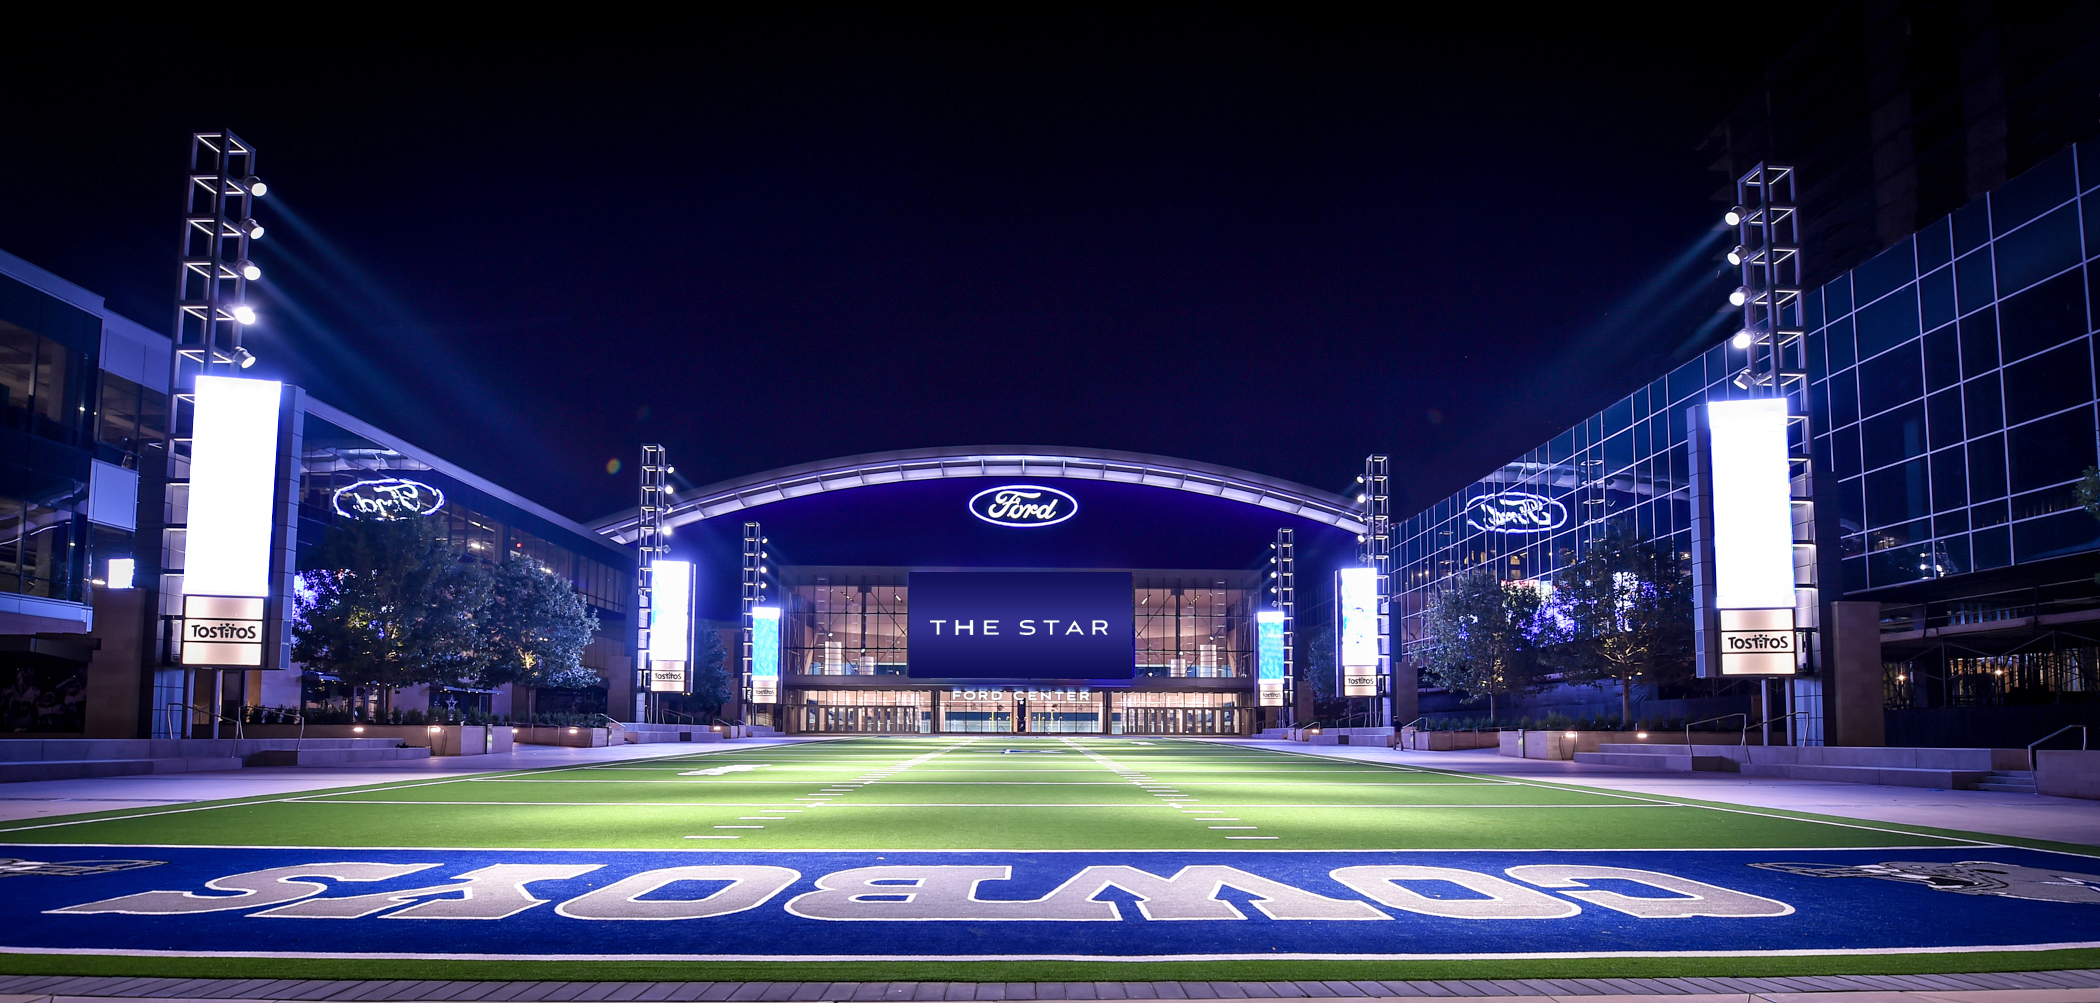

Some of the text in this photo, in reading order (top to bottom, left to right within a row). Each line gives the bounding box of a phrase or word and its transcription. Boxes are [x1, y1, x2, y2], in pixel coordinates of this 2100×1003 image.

[988, 490, 1058, 519] Ford
[930, 619, 1109, 636] THE STAR
[952, 690, 1090, 701] FORD CENTER
[41, 862, 1796, 921] COWBOYS
